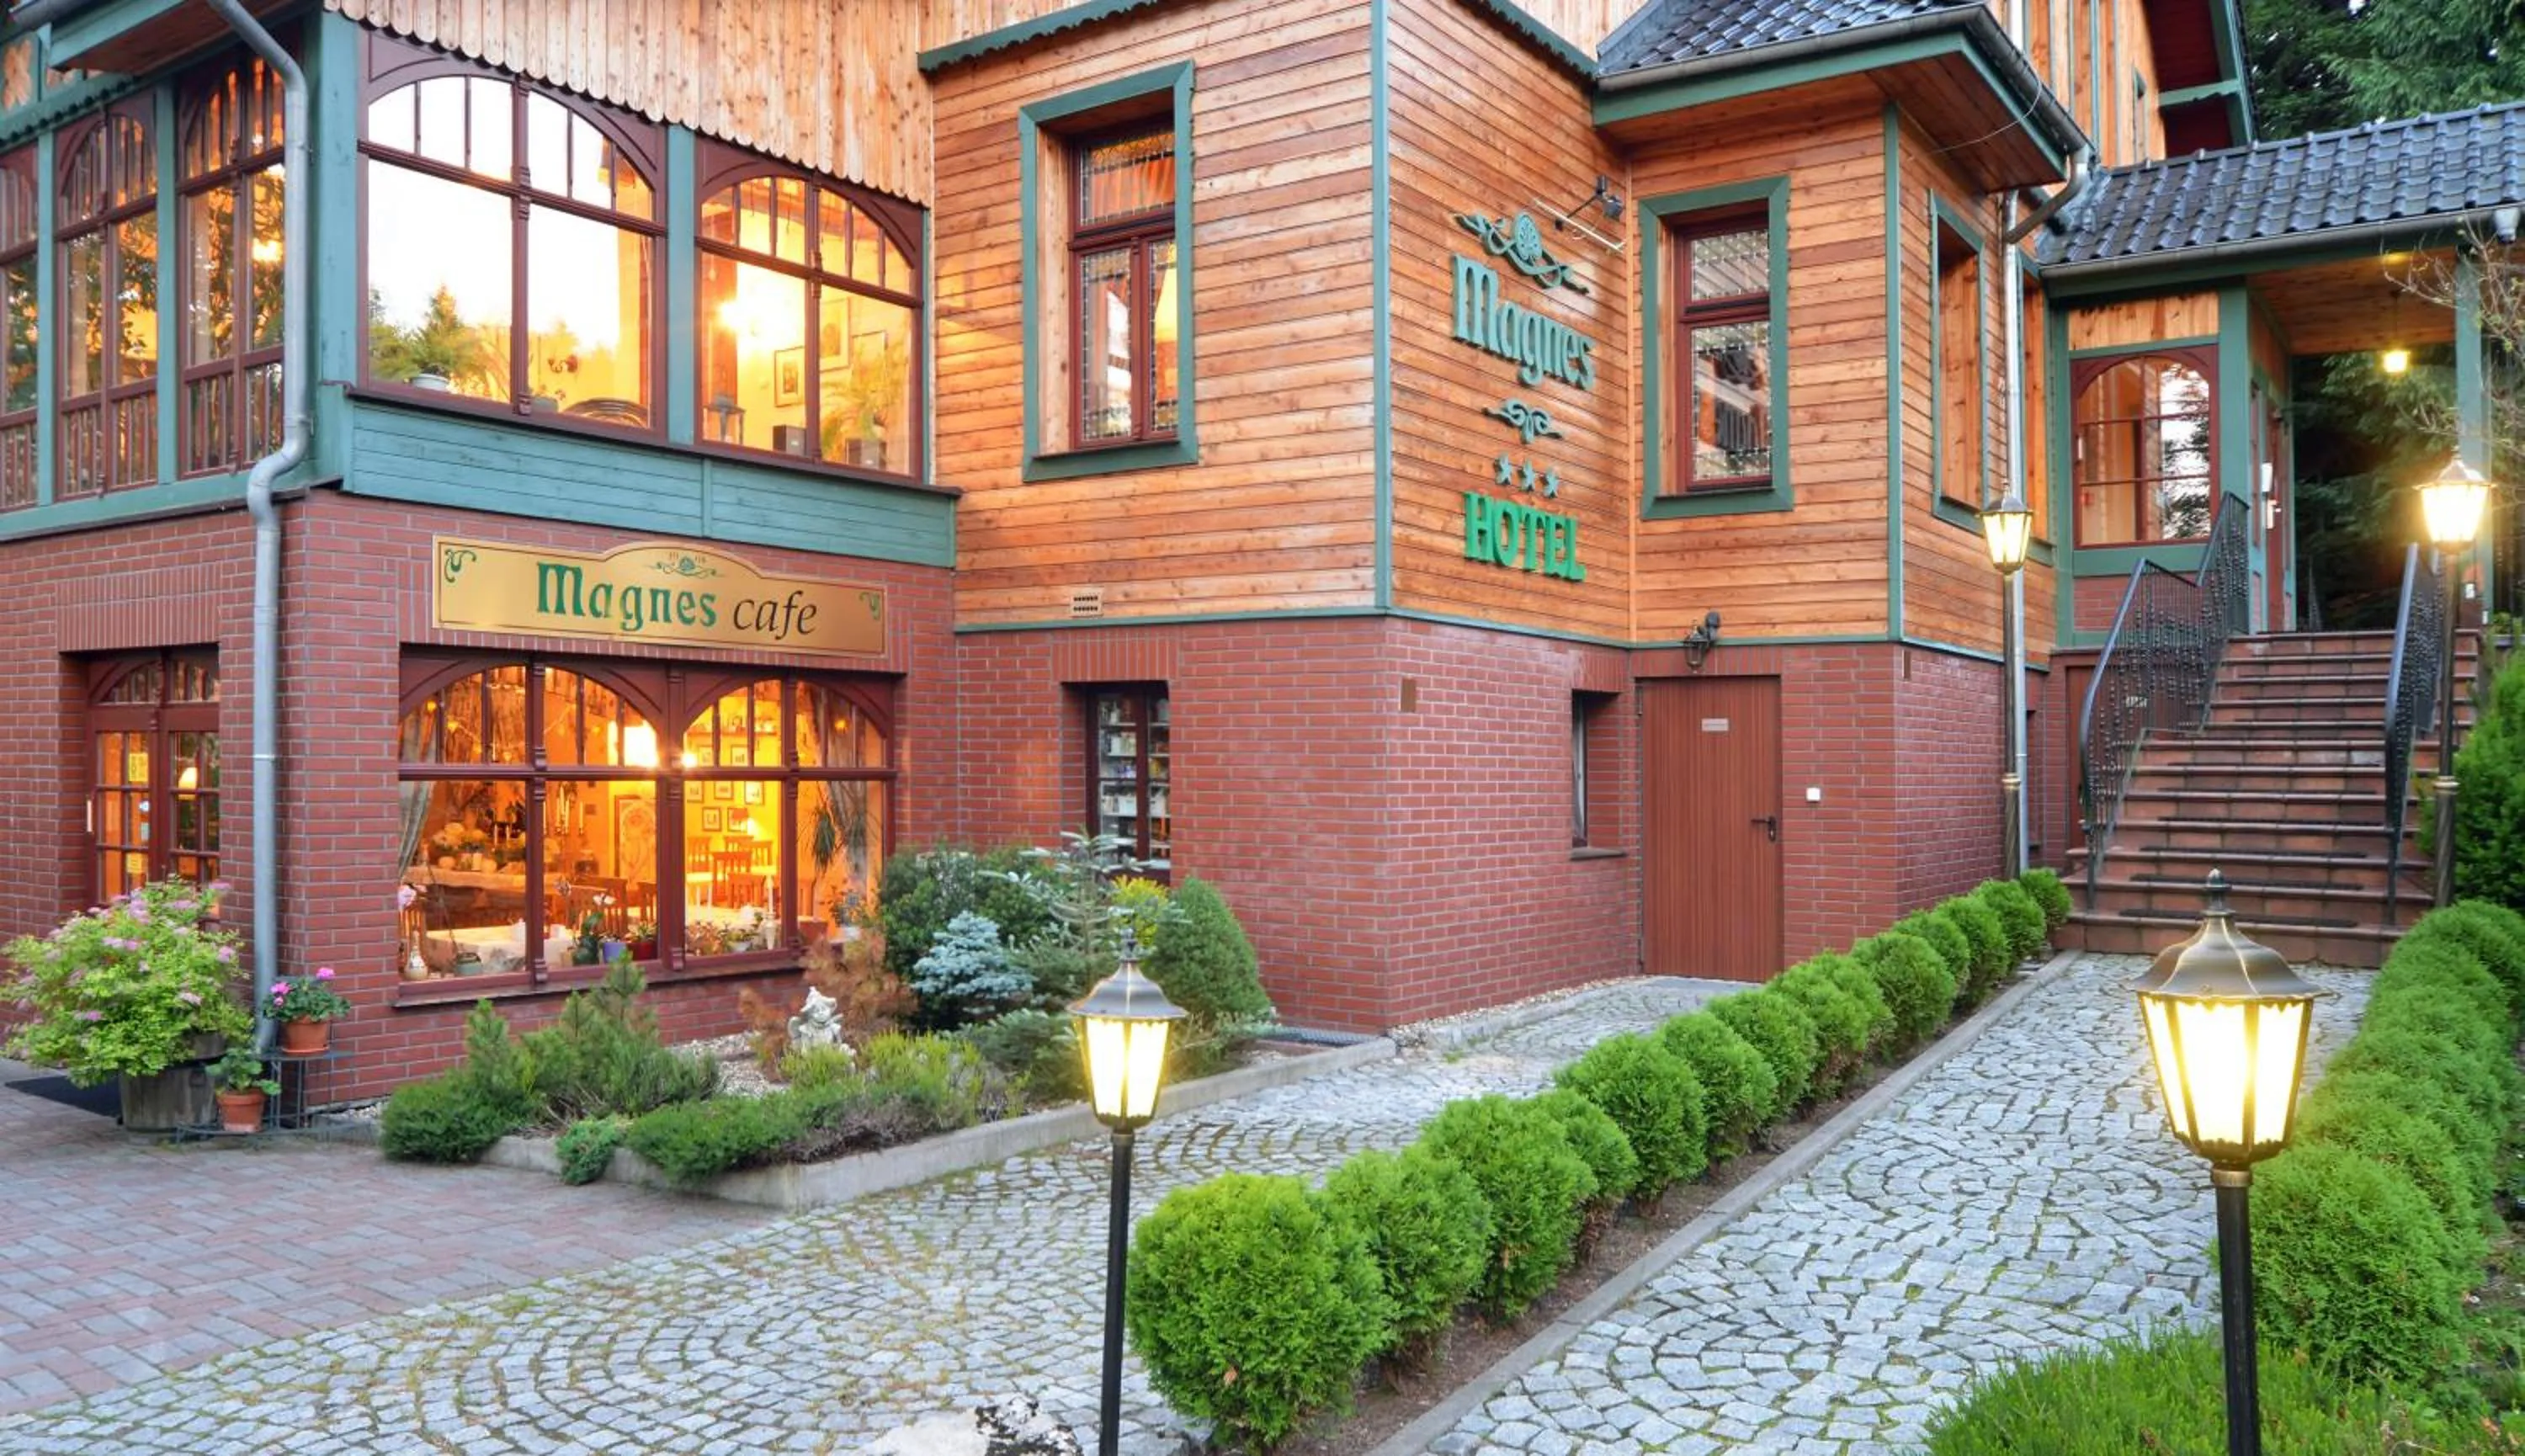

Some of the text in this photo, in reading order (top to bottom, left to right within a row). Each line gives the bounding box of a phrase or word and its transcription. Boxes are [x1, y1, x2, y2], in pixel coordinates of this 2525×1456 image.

[1454, 256, 1595, 388] Magnes
[1463, 491, 1586, 582] HOTEL
[536, 561, 818, 640] Magnes cafe
